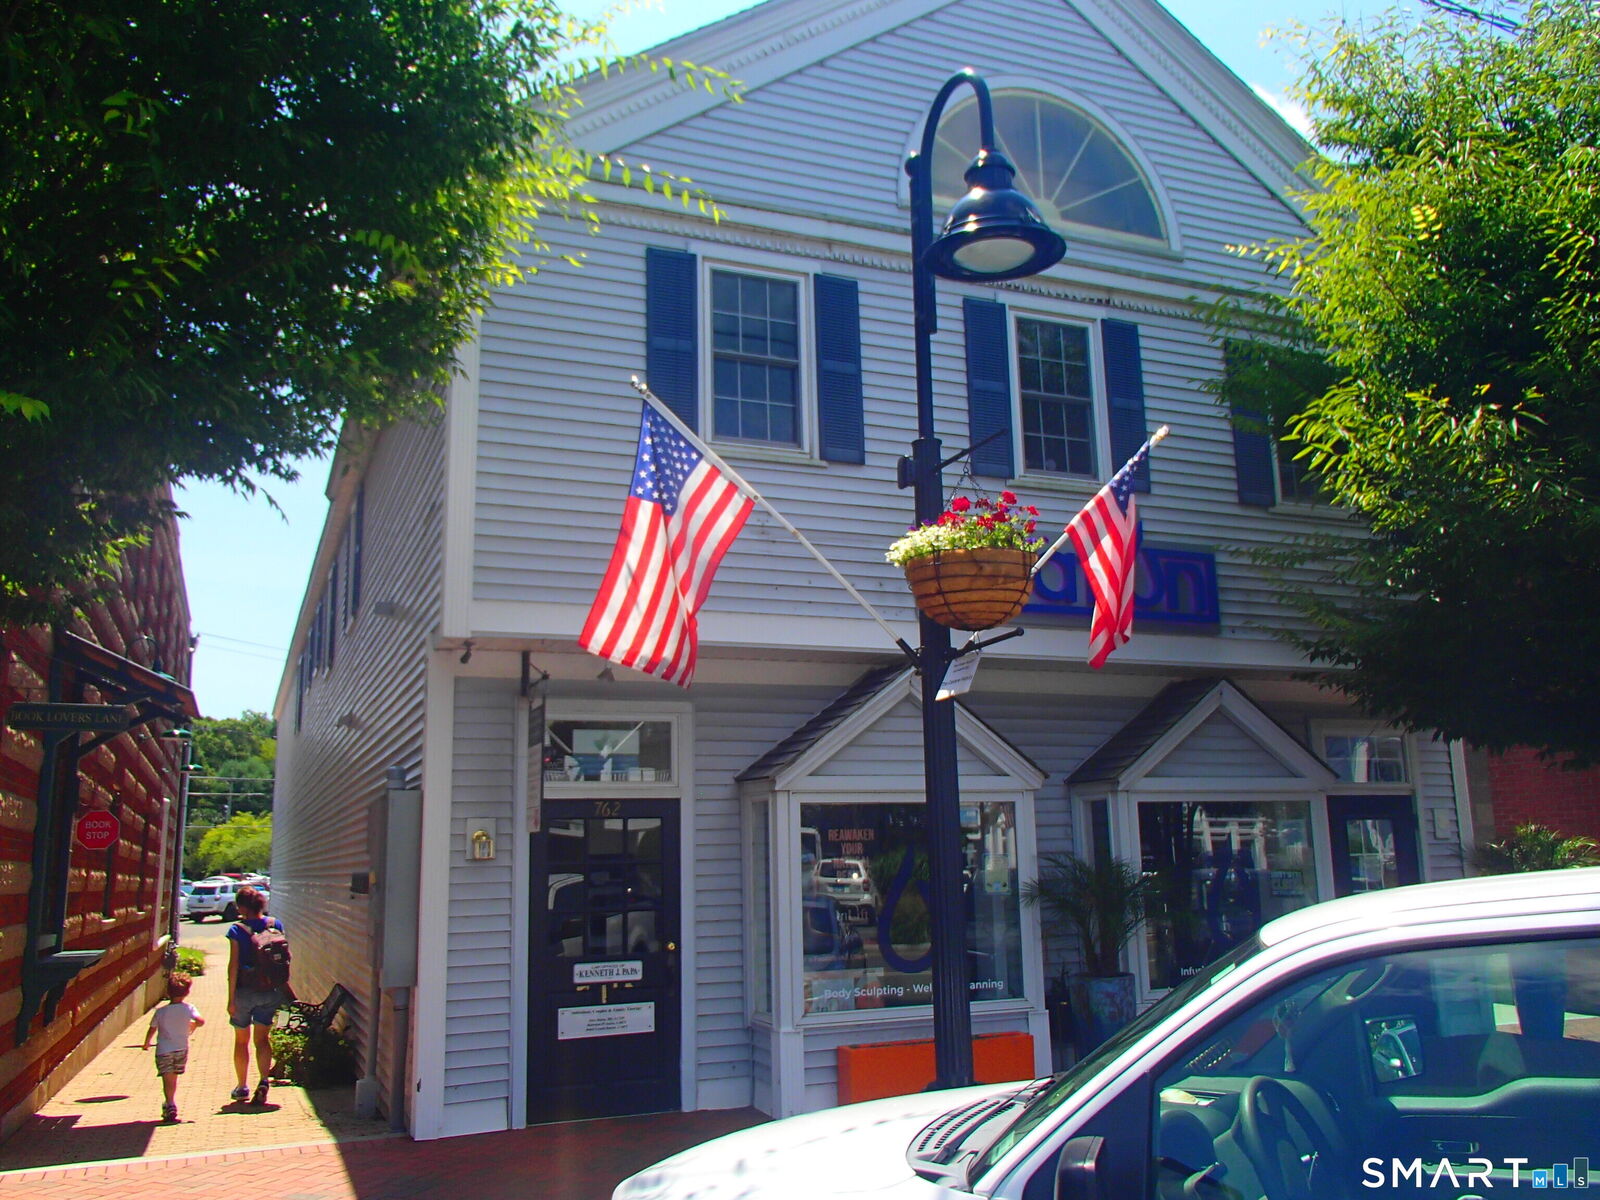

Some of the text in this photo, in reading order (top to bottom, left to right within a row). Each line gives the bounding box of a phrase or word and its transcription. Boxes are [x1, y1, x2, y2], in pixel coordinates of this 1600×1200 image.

[11, 711, 45, 722] BOOK
[48, 711, 92, 723] LOVERS
[594, 800, 621, 817] 762
[85, 820, 112, 829] BOOK
[86, 831, 110, 840] STOP
[828, 829, 875, 841] REAWAKEN
[841, 842, 864, 854] YOUR
[579, 968, 614, 977] KENNETH
[622, 967, 638, 975] PAPA
[824, 988, 852, 999] Body
[854, 985, 904, 998] Sculpting
[912, 983, 932, 993] Wel
[969, 979, 1004, 990] anning
